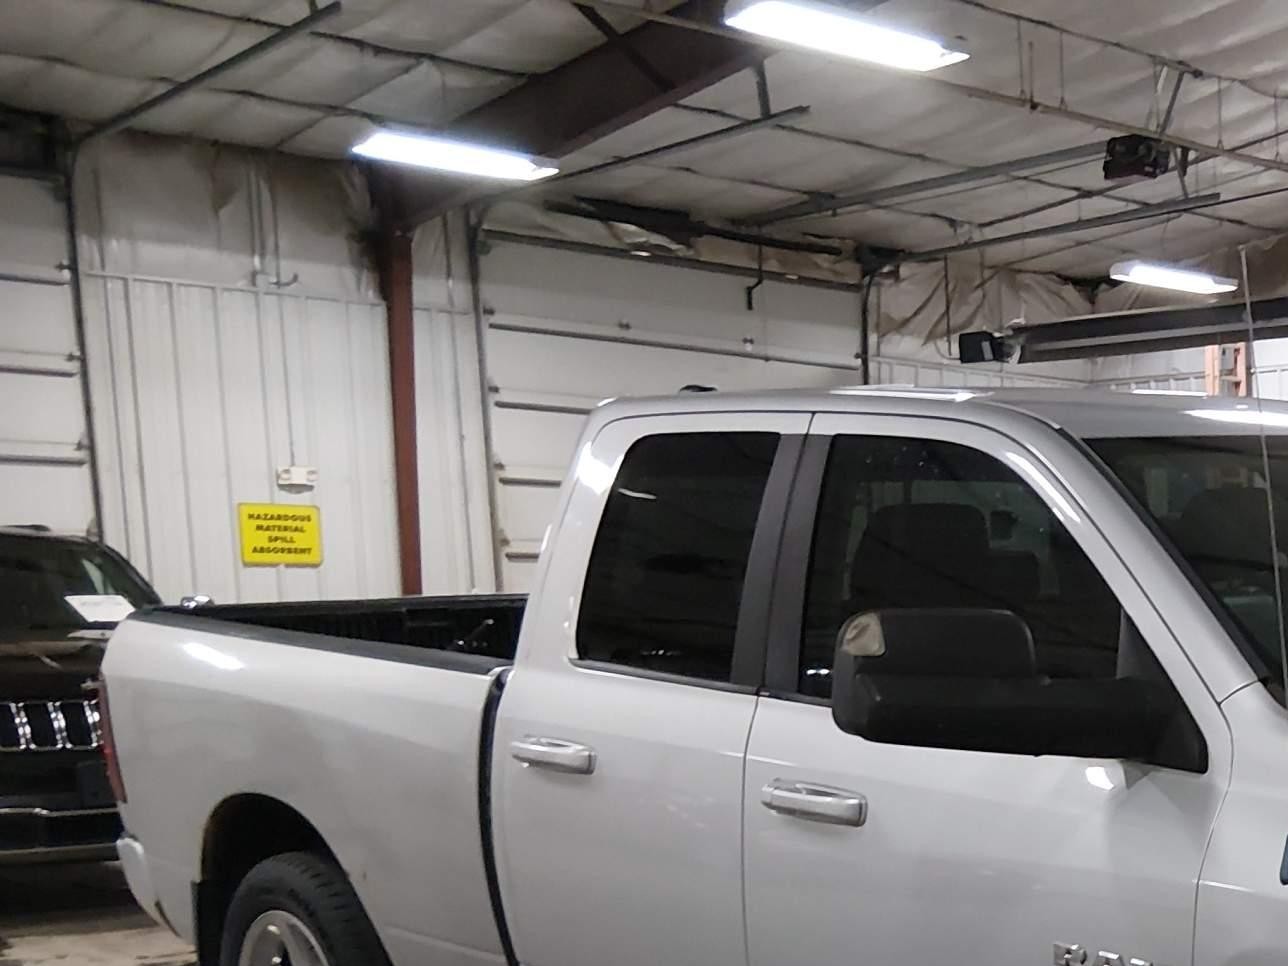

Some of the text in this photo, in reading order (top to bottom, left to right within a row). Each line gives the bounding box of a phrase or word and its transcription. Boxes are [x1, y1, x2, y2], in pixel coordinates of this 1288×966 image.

[248, 513, 311, 522] HAZARDOUS
[255, 524, 305, 533] MATERIAL
[268, 535, 295, 543] SPILL
[252, 546, 312, 555] ABSORBENT
